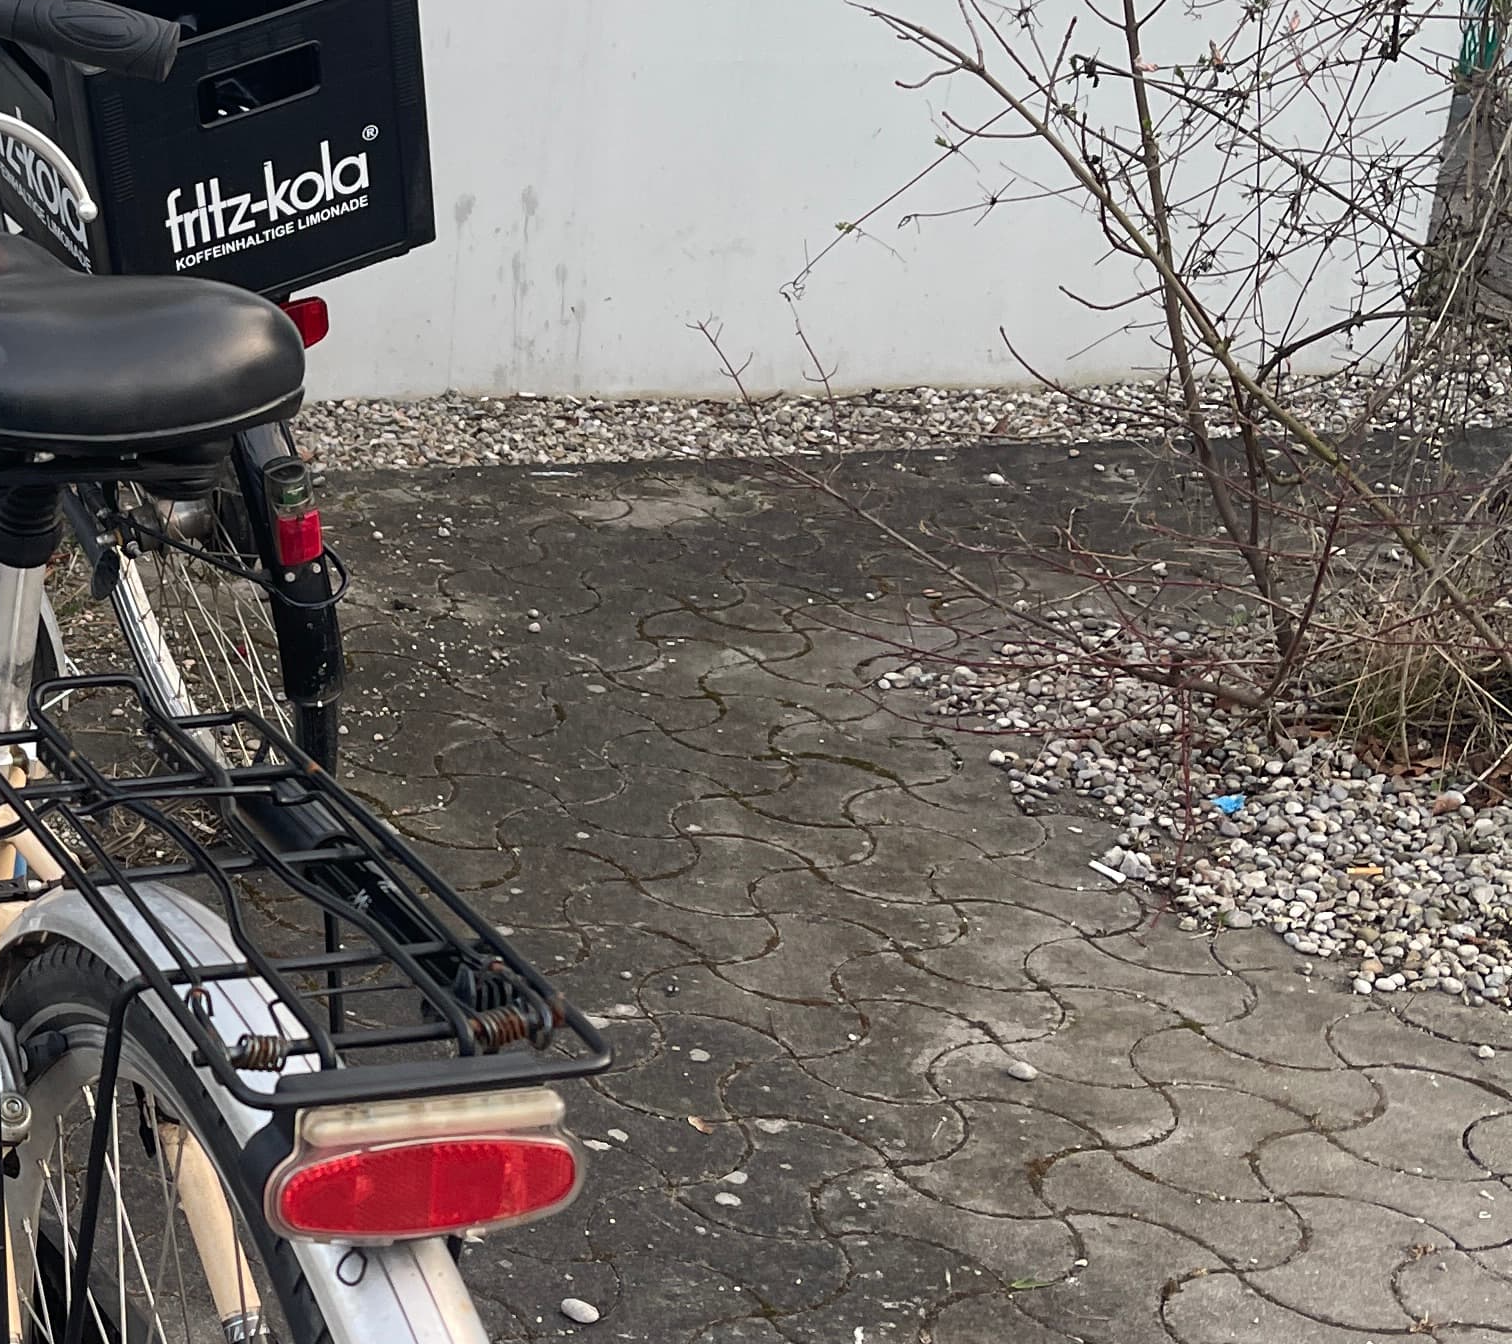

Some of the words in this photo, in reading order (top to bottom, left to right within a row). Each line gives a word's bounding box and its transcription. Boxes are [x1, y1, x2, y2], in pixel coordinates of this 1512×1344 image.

[165, 140, 369, 253] fritz-kola
[175, 222, 295, 271] KOFFEINHALTIGE
[298, 195, 369, 230] LIMONADE
